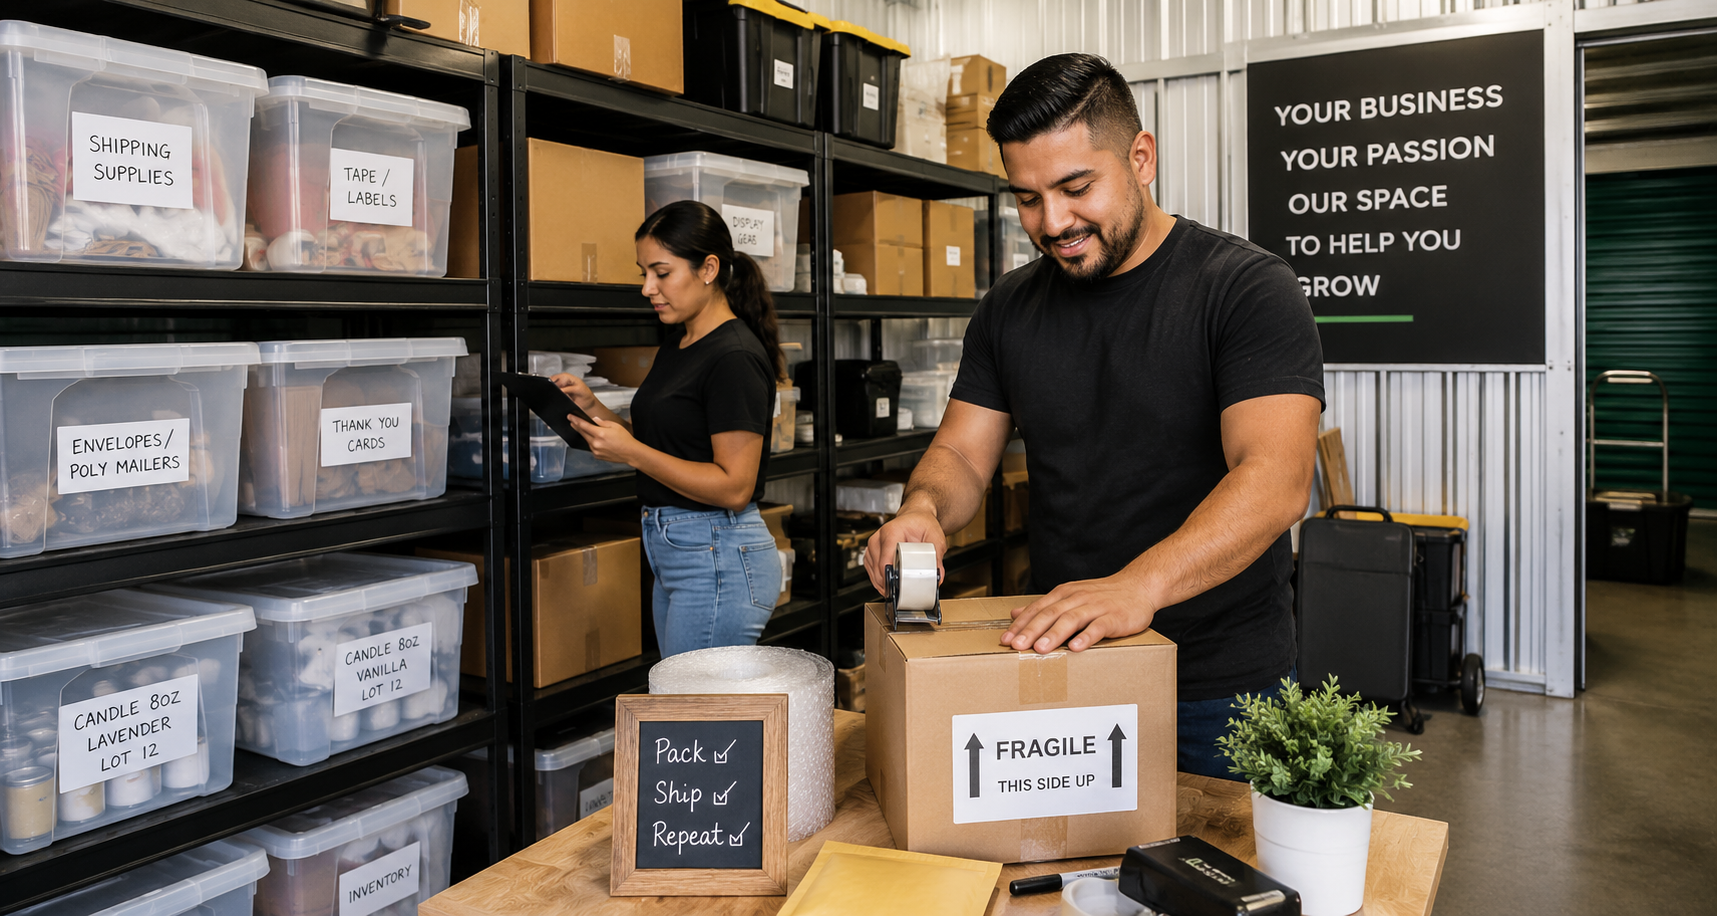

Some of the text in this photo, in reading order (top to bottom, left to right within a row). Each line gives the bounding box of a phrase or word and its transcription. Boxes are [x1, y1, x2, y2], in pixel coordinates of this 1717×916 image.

[1275, 85, 1503, 126] YOUR BUSINESS
[90, 135, 170, 159] SHIPPING
[1281, 135, 1494, 171] YOUR PASSION
[94, 164, 173, 186] SUPPLIES
[344, 168, 390, 187] TAPE /
[348, 191, 396, 207] LABELS
[1289, 185, 1447, 214] OUR SPACE
[733, 216, 764, 231] DISPLAY
[1286, 229, 1460, 255] TO HELP YOU
[333, 417, 399, 432] THANK YOU
[348, 437, 385, 452] CARDS
[70, 456, 180, 479] POLY MAILERS
[345, 642, 391, 666] CANDLE
[356, 658, 408, 682] VANILLA
[362, 679, 403, 701] LOT 12
[74, 700, 140, 731] CANDLE
[88, 716, 172, 752] LAVENDER
[101, 743, 159, 772] LOT 12
[656, 738, 706, 764] Pack
[997, 736, 1096, 760] FRAGILE
[998, 774, 1095, 792] THIS SIDE UP
[655, 781, 702, 812] Ship
[653, 821, 724, 855] Repeat
[349, 864, 412, 904] INVENTORY
